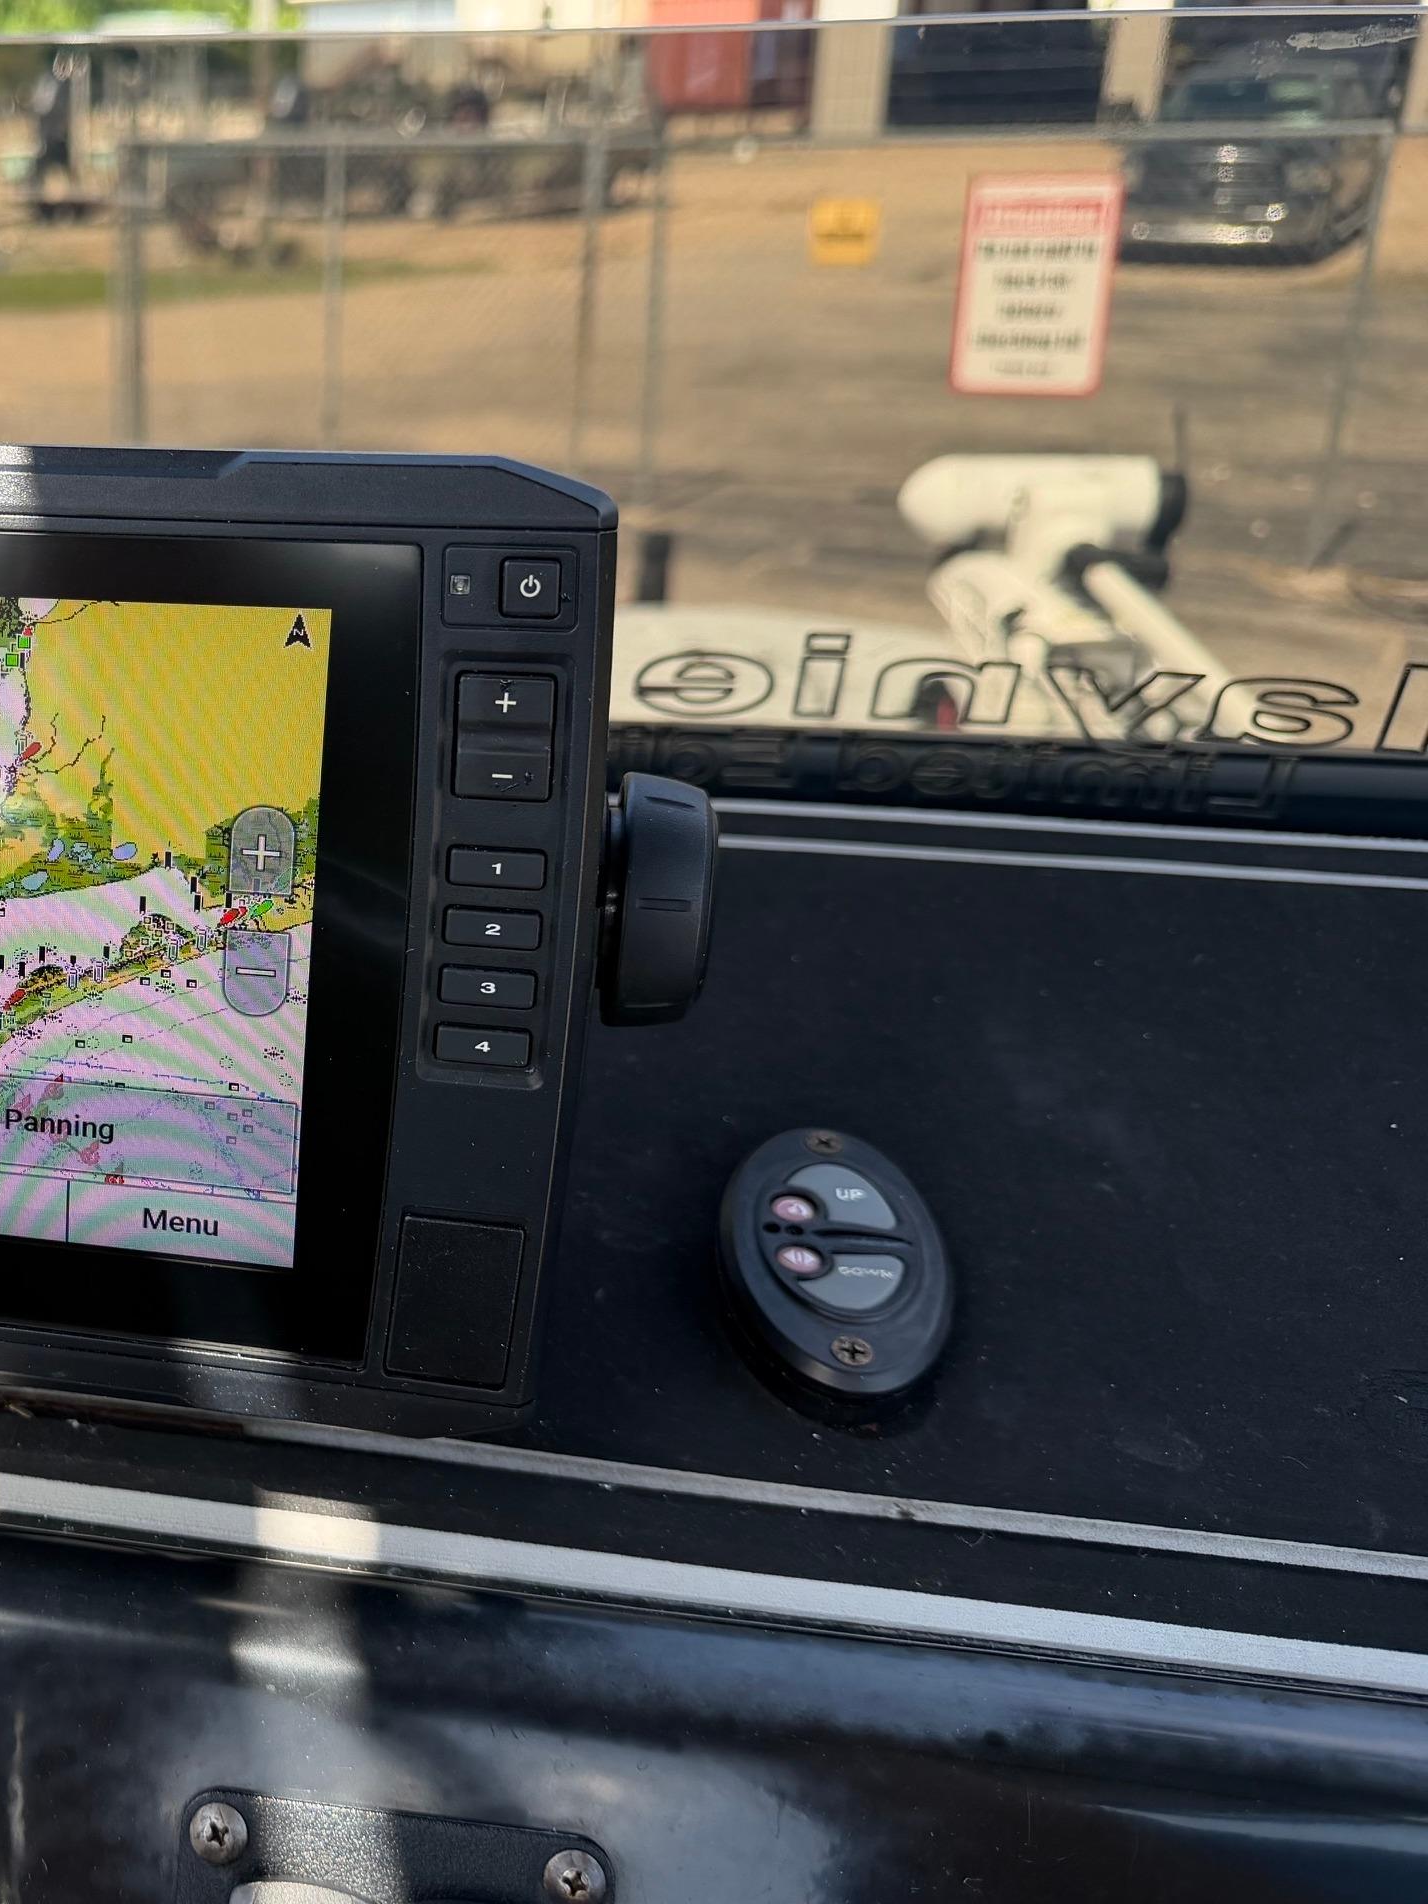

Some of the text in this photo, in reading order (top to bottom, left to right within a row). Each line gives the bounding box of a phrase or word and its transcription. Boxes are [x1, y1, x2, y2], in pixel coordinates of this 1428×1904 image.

[491, 863, 502, 875] 1
[485, 923, 501, 936] 2
[480, 982, 496, 994] 3
[474, 1040, 491, 1053] 4
[4, 1110, 116, 1144] Panning
[835, 1188, 865, 1201] UP
[141, 1207, 220, 1237] Menu
